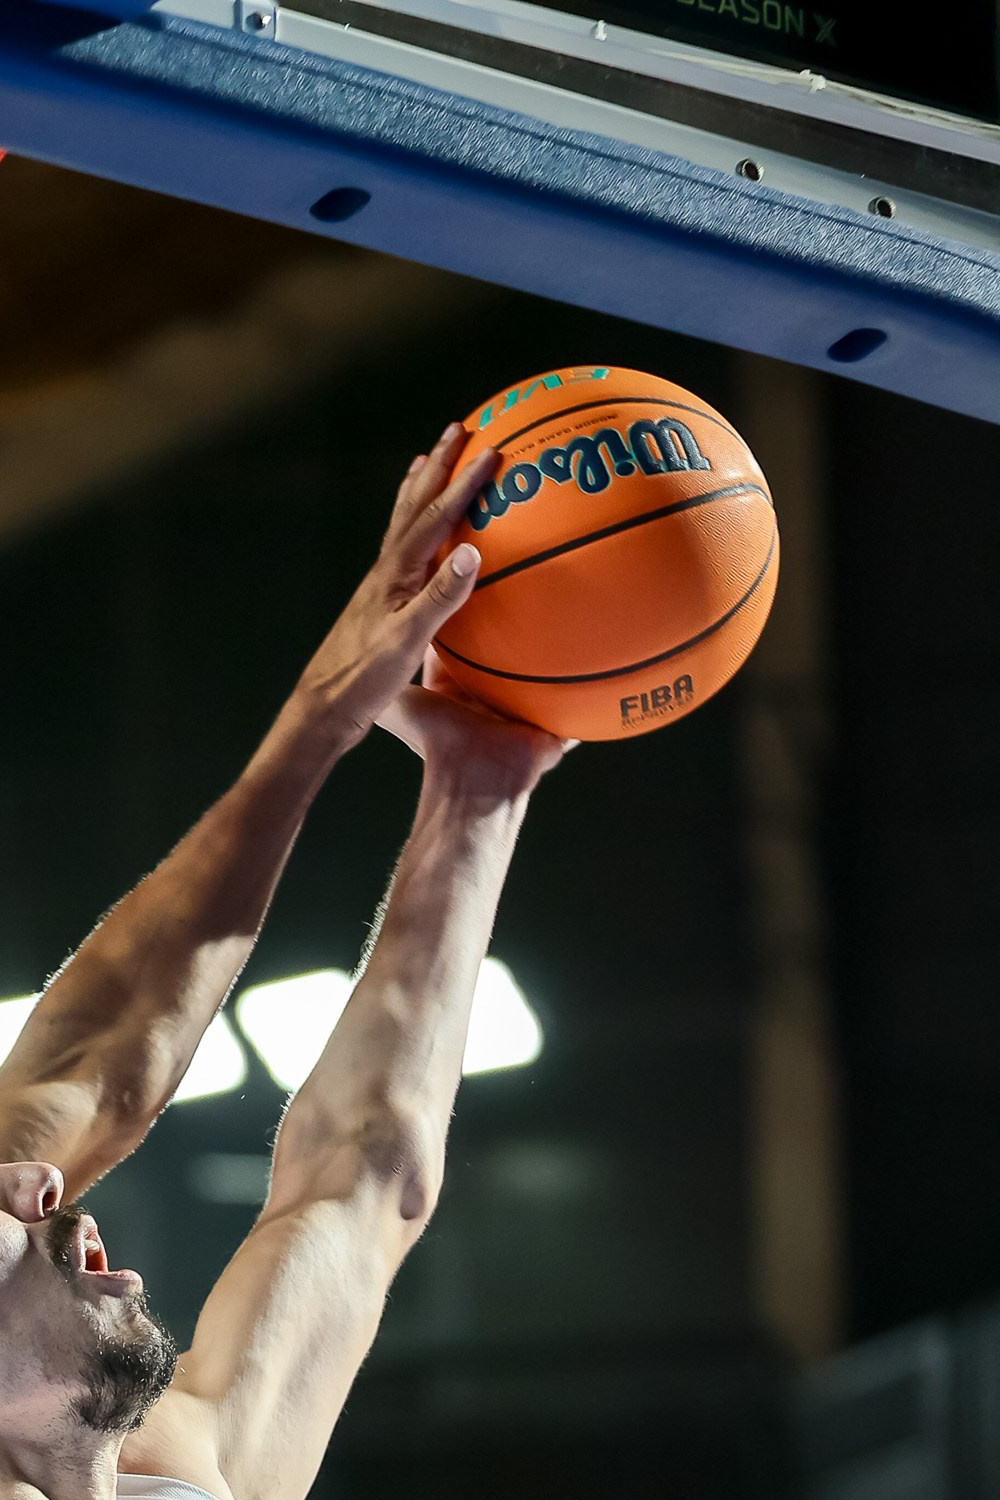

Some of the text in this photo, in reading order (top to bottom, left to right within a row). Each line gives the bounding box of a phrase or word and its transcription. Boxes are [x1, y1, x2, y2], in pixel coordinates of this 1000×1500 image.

[677, 0, 805, 37] ASON
[467, 416, 712, 532] Wilson
[620, 674, 693, 718] FIBA
